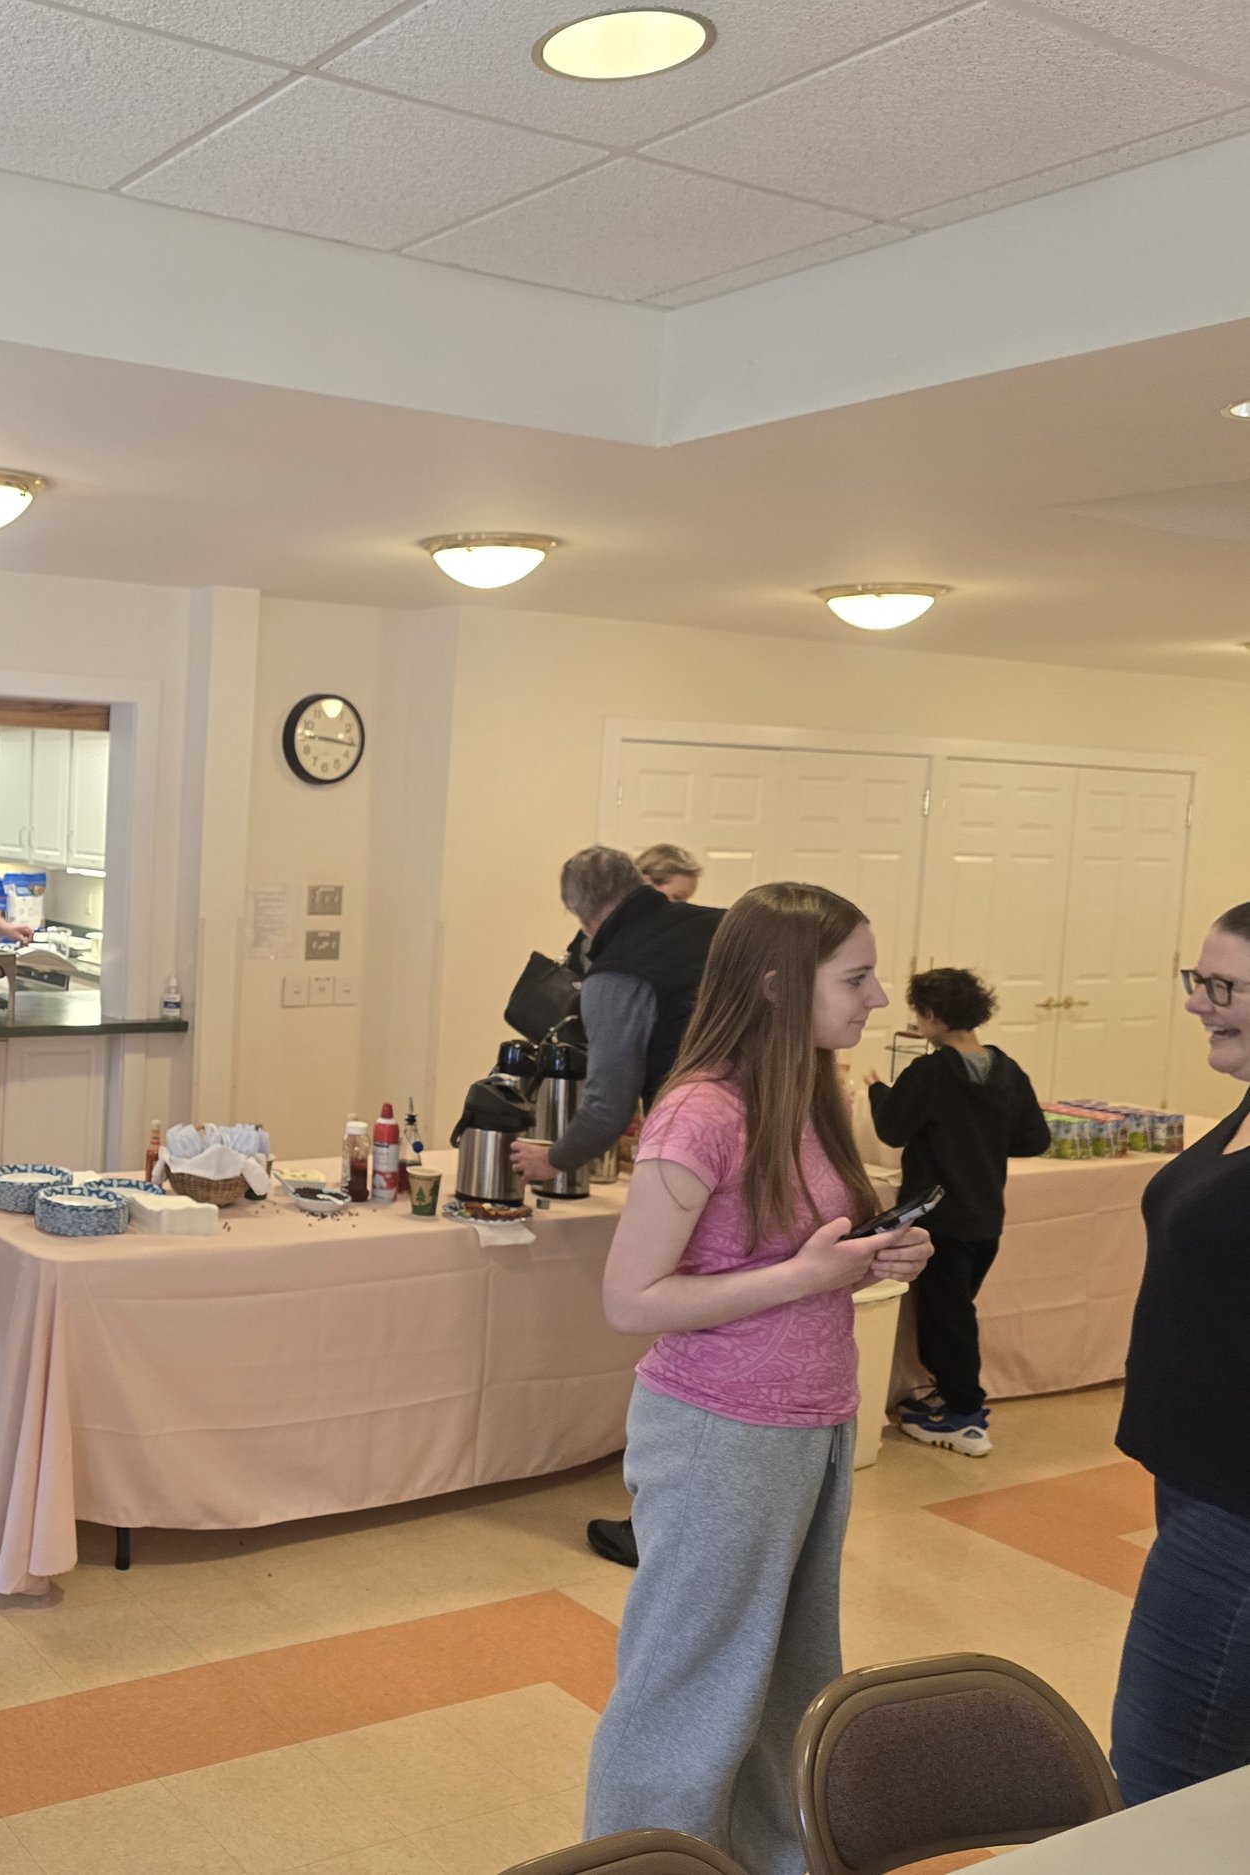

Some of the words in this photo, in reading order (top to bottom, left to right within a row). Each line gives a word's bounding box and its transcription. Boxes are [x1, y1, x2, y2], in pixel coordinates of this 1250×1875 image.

[304, 720, 314, 729] 10
[345, 723, 352, 733] 2
[303, 745, 310, 755] 8
[343, 750, 349, 759] 4
[312, 756, 318, 766] 7
[321, 763, 328, 773] 6
